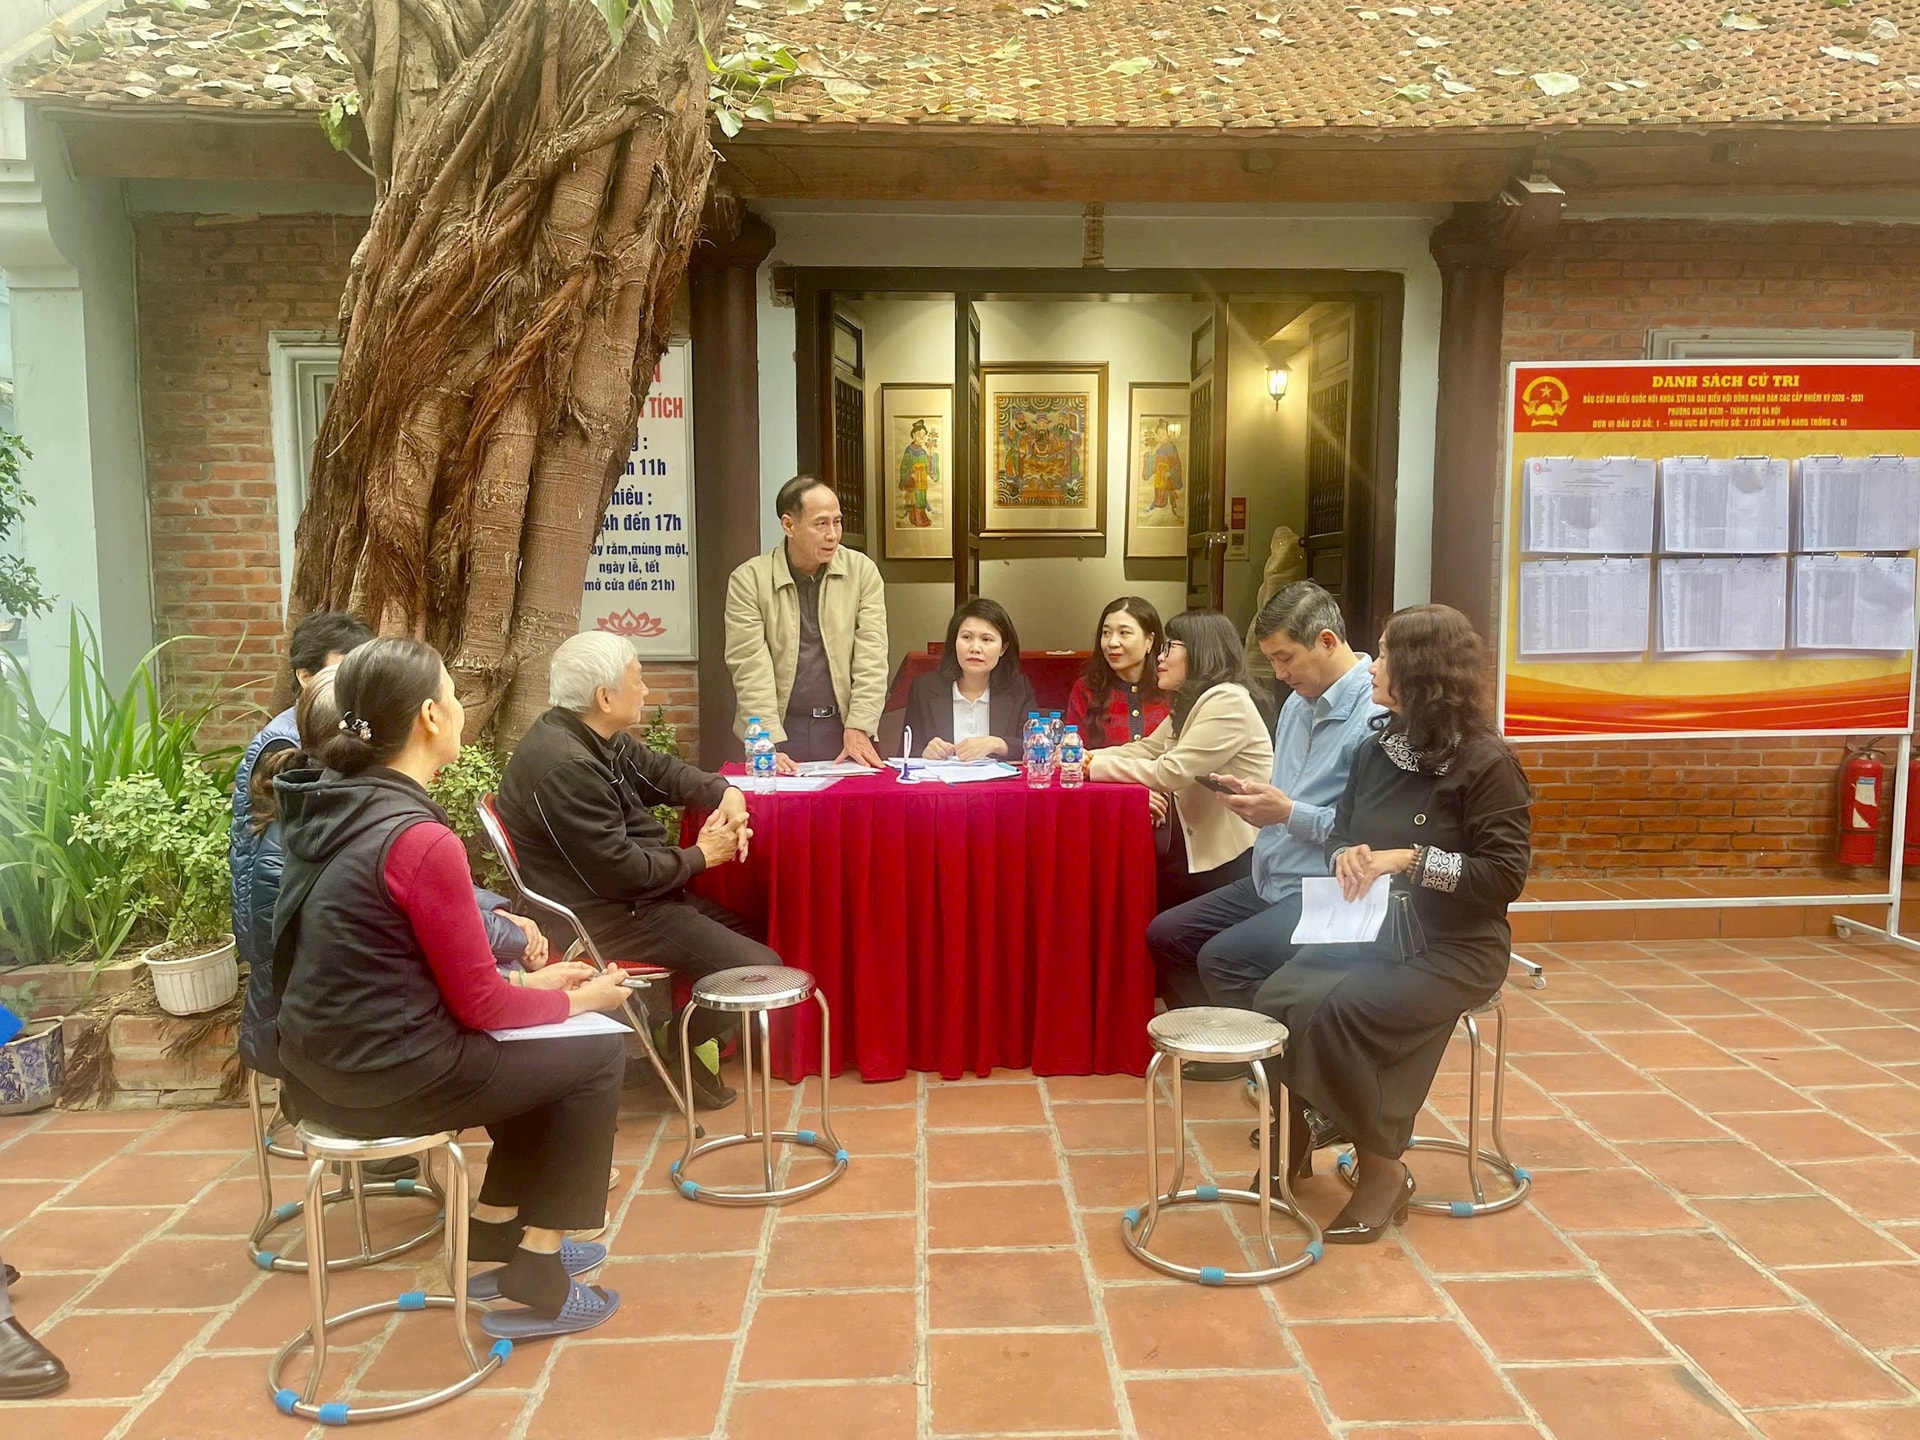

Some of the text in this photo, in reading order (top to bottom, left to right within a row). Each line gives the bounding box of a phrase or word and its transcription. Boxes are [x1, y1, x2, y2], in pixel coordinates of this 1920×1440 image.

[1652, 372, 1800, 388] DANH SÁCH CỬ TRI
[648, 392, 684, 419] TÍCH
[1744, 418, 1749, 427] 2
[640, 459, 666, 476] 11h
[611, 484, 643, 506] hiều
[603, 511, 682, 532] 4h đến 17h
[664, 542, 689, 558] một,
[599, 561, 625, 574] ngày
[645, 559, 660, 573] tết
[584, 577, 675, 592] mở cửa đến 21h)
